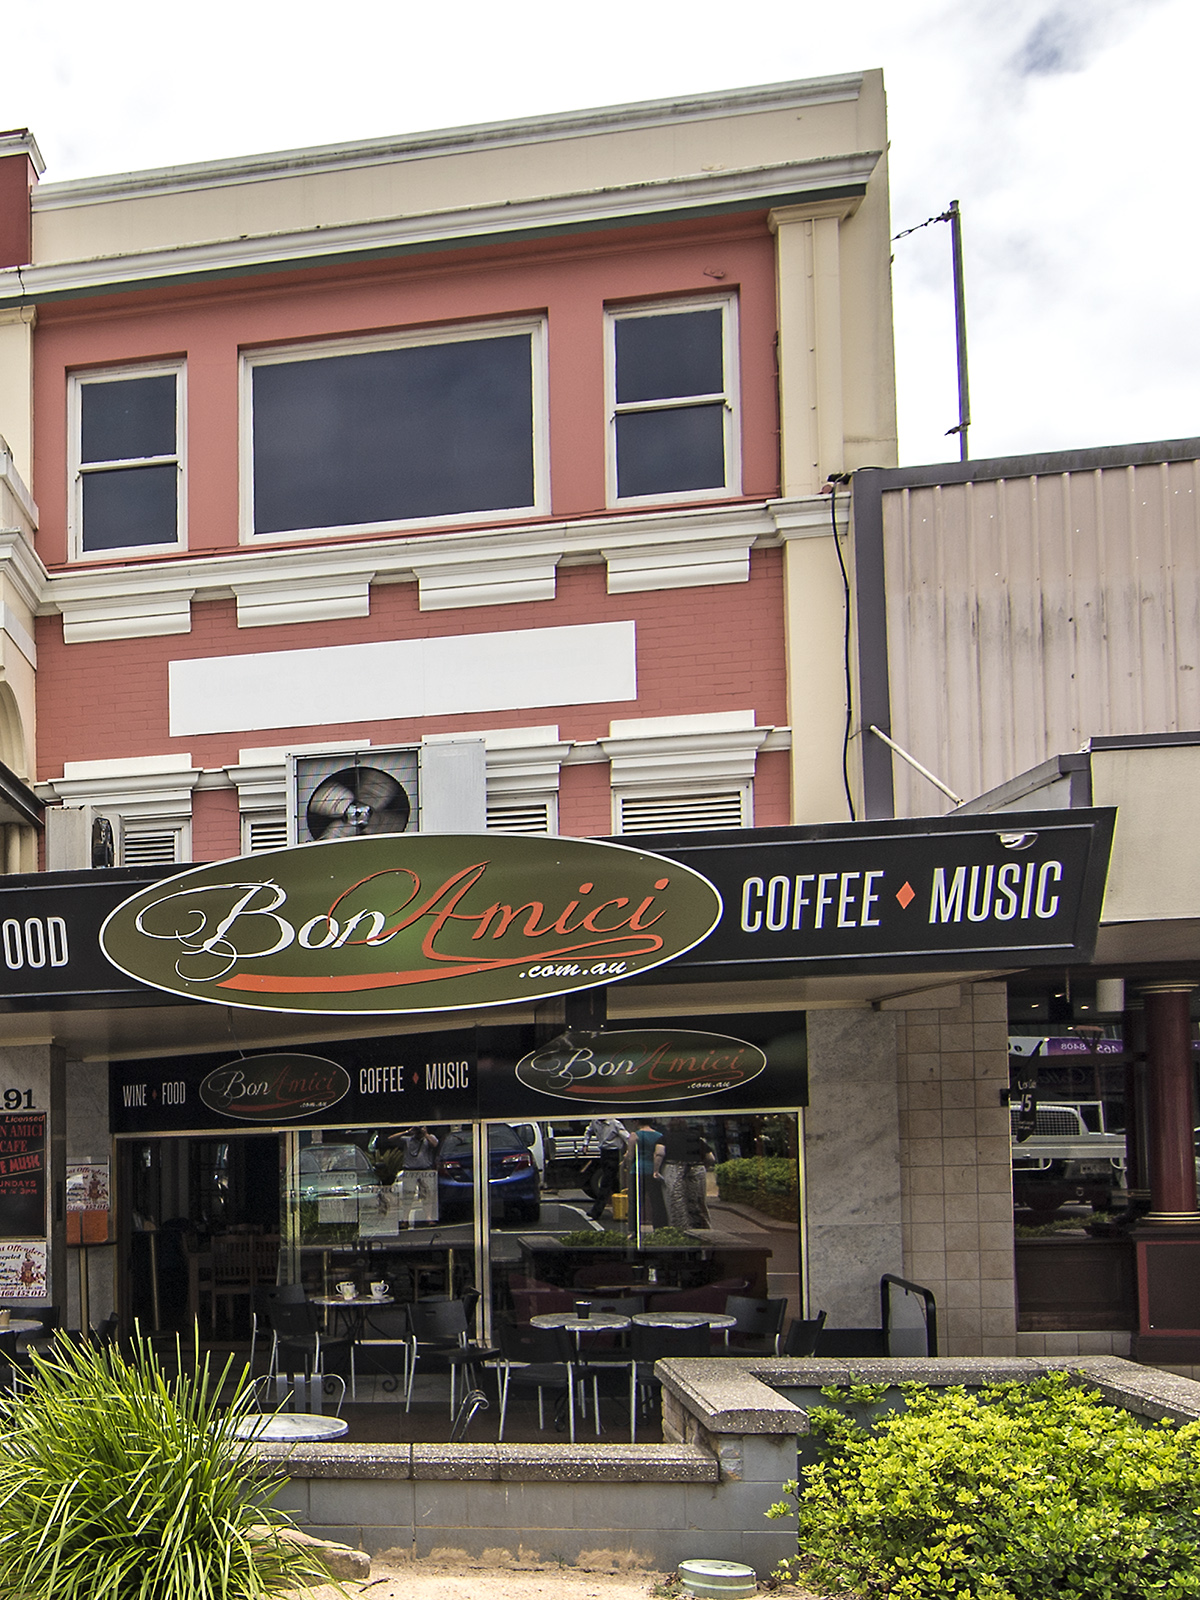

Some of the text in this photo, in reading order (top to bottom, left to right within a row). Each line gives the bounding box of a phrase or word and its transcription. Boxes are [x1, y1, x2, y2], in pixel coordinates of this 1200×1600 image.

[741, 860, 1063, 933] COFFEE MUSIC
[135, 860, 670, 981] Bon Amici
[519, 958, 628, 979] .com.au
[360, 1061, 470, 1095] COFFEE MUSIC
[535, 1041, 746, 1090] Bon Amici
[122, 1080, 187, 1107] WINE FOOD
[207, 1064, 338, 1108] Bon Amici
[5, 1114, 46, 1124] Licensed
[9, 1123, 43, 1138] AMICI
[9, 1153, 41, 1173] MUSIC
[6, 1244, 46, 1258] Offenders
